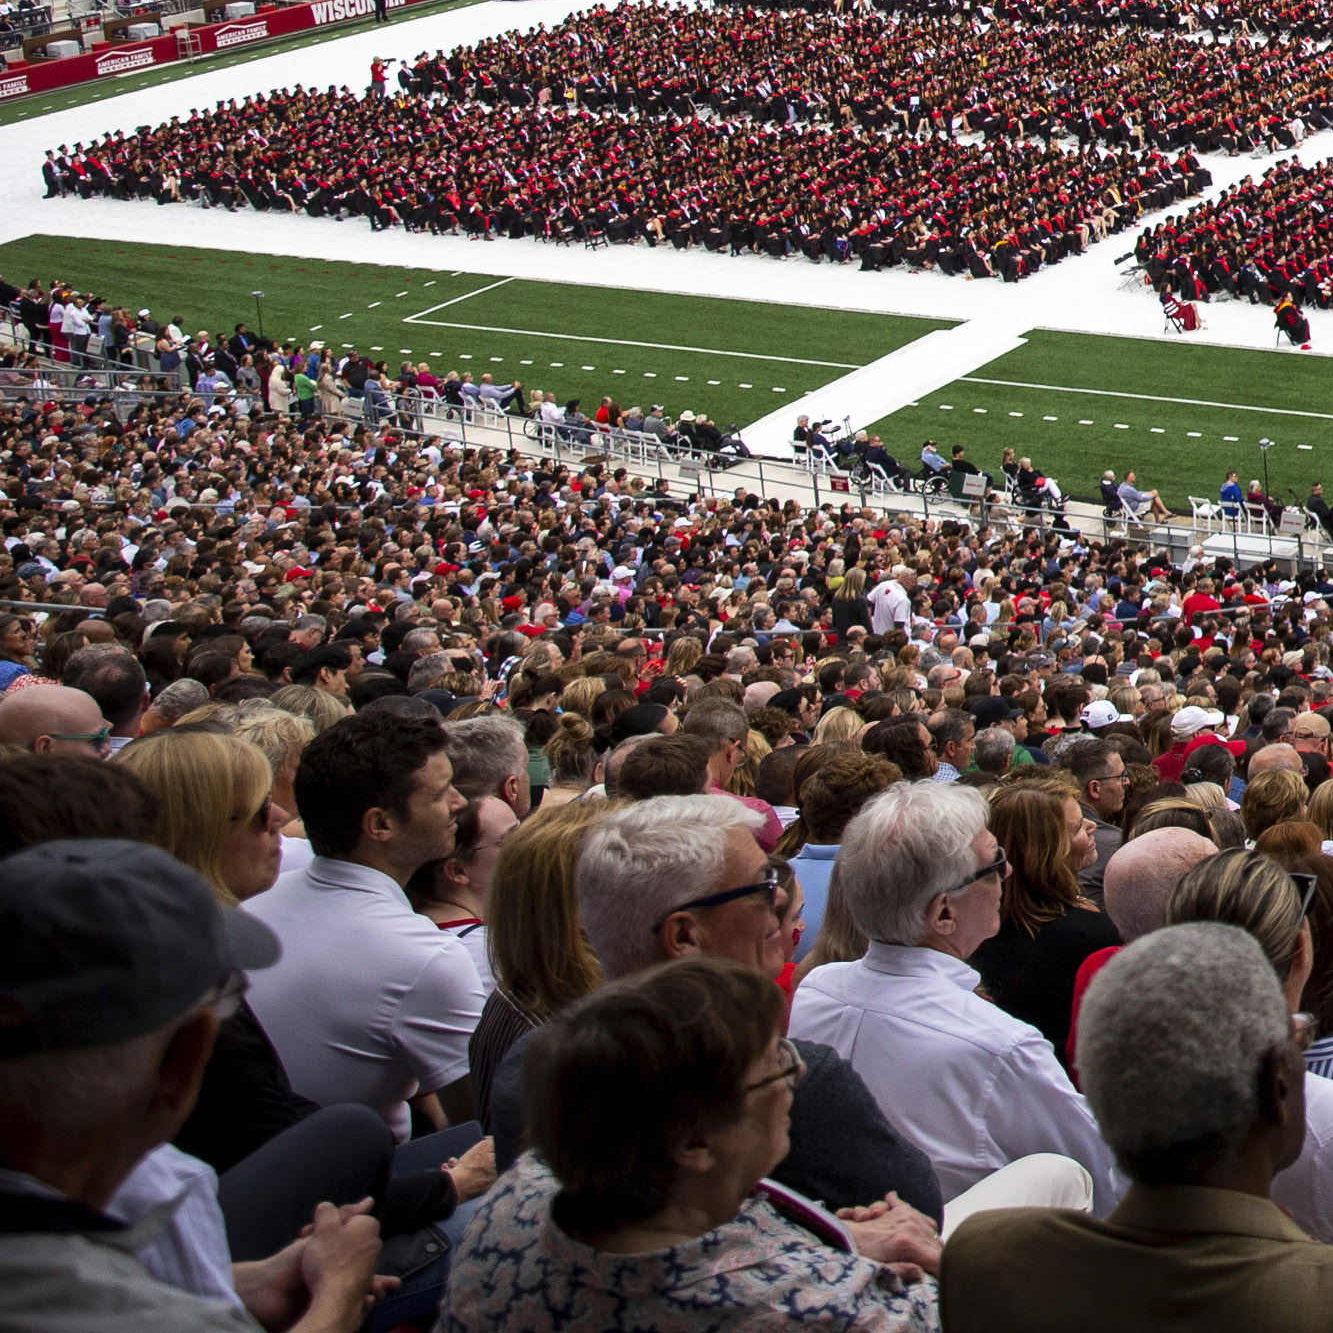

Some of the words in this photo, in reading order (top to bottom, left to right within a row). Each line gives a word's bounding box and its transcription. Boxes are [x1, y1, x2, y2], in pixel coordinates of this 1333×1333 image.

[217, 29, 246, 40] AMERICAN
[246, 25, 266, 34] FAMILY
[98, 56, 130, 67] AMERICAN
[130, 50, 152, 61] FAMILY
[102, 59, 148, 72] INSURANCE
[2, 79, 27, 89] FAMILY
